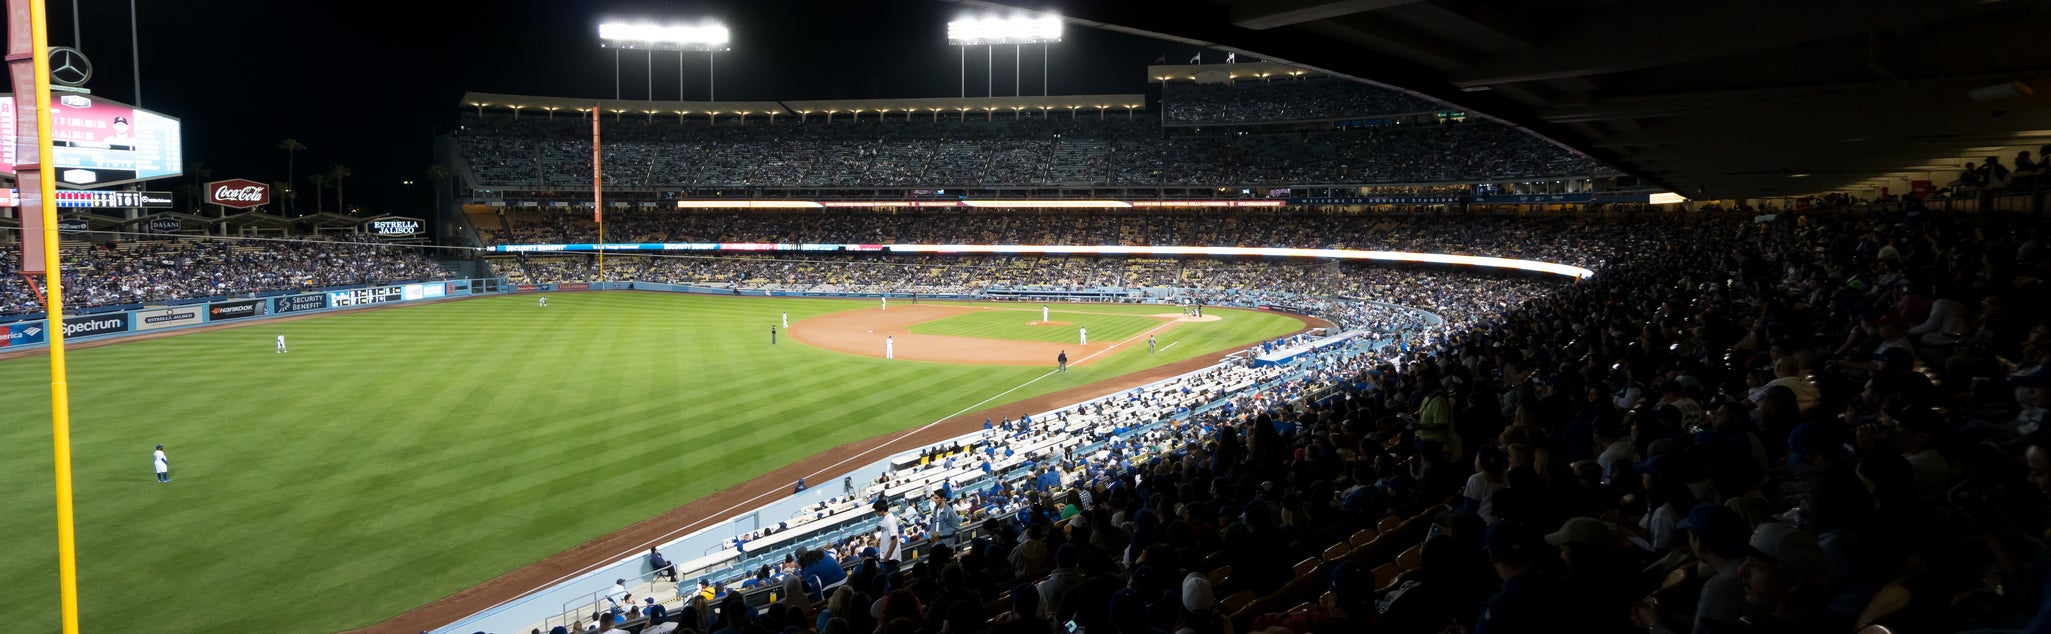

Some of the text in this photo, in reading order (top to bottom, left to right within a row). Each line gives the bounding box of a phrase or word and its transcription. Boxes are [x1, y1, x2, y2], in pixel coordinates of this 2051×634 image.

[215, 185, 264, 201] Coca-Cola
[374, 221, 418, 229] ESTRELLA
[506, 244, 537, 252] SECURITY
[292, 295, 323, 303] SECURITY
[62, 319, 120, 336] Spectrum
